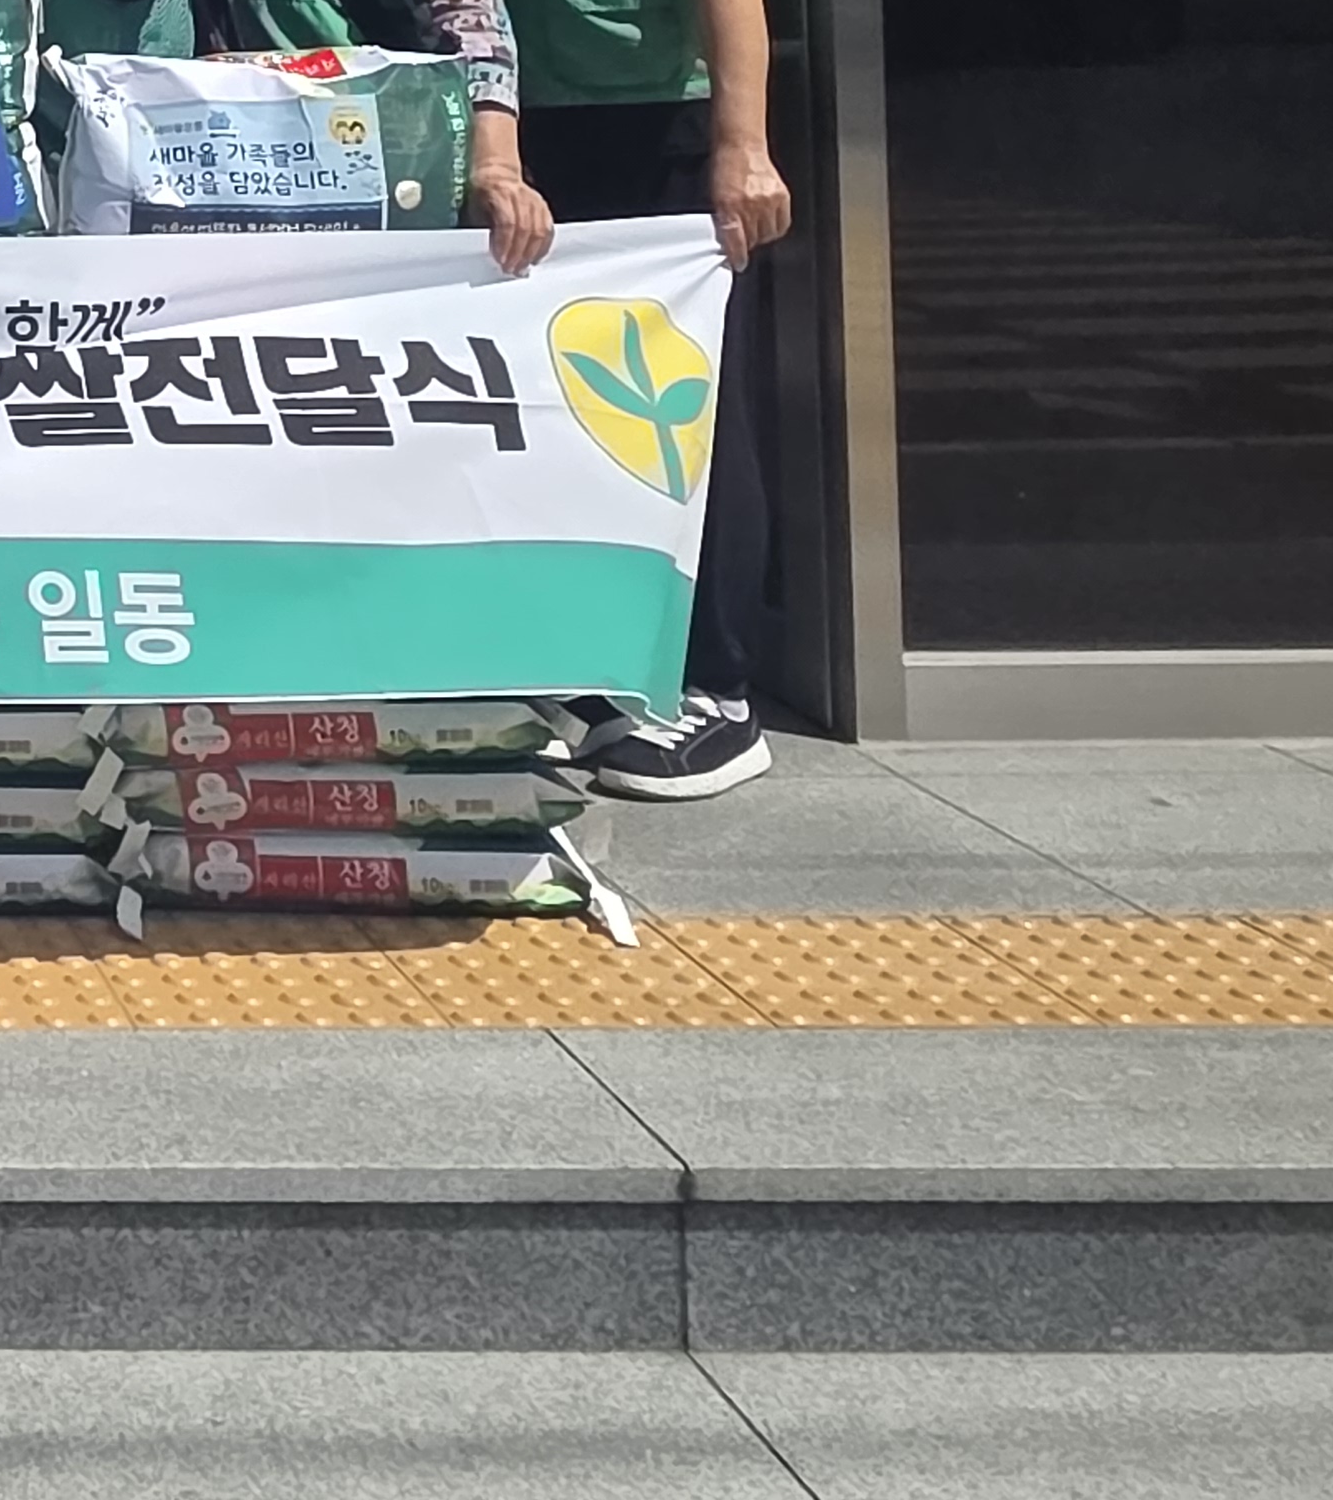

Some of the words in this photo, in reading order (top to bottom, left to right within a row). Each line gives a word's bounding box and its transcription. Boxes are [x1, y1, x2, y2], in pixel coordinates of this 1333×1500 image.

[150, 142, 218, 168] 새마을
[226, 141, 315, 168] 가족들의
[228, 169, 348, 197] 담았습니다.
[26, 570, 197, 666] 일동
